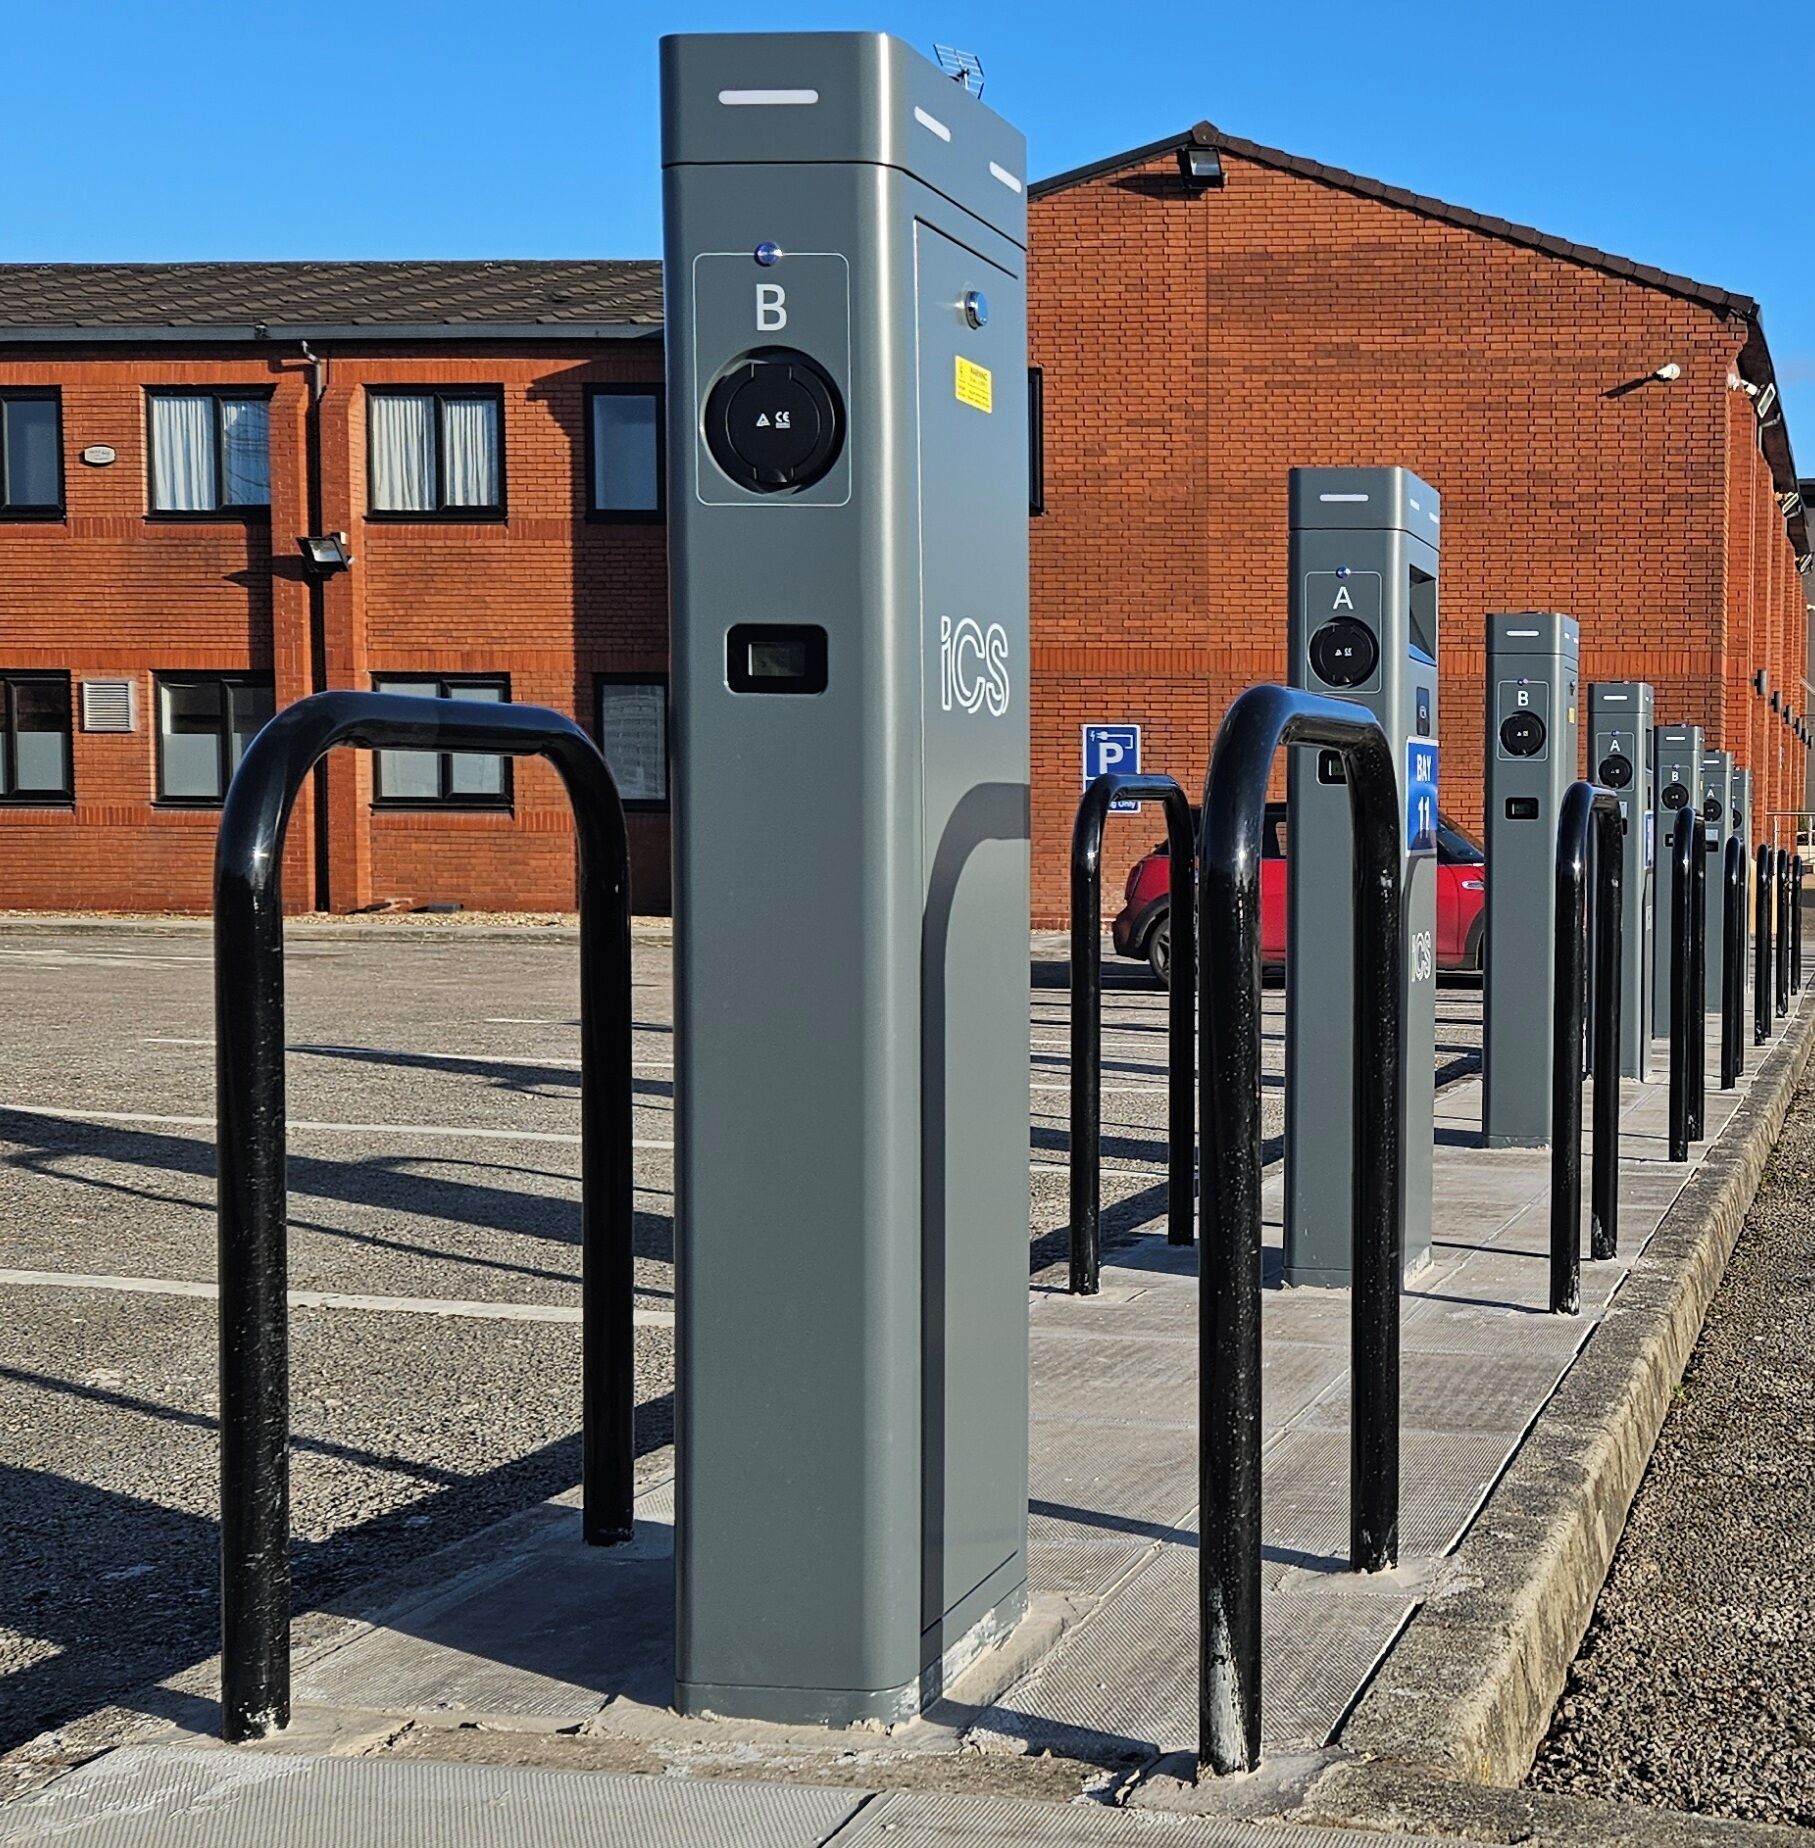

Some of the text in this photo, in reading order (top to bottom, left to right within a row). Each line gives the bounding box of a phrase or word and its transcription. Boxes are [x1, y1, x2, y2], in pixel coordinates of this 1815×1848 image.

[756, 283, 787, 331] B
[1333, 586, 1354, 610] A
[1517, 690, 1529, 706] B
[1098, 742, 1124, 774] P
[1609, 740, 1621, 752] A
[1416, 753, 1432, 783] BAY
[1671, 771, 1680, 782] B
[1706, 788, 1715, 798] A
[1417, 796, 1430, 839] 11
